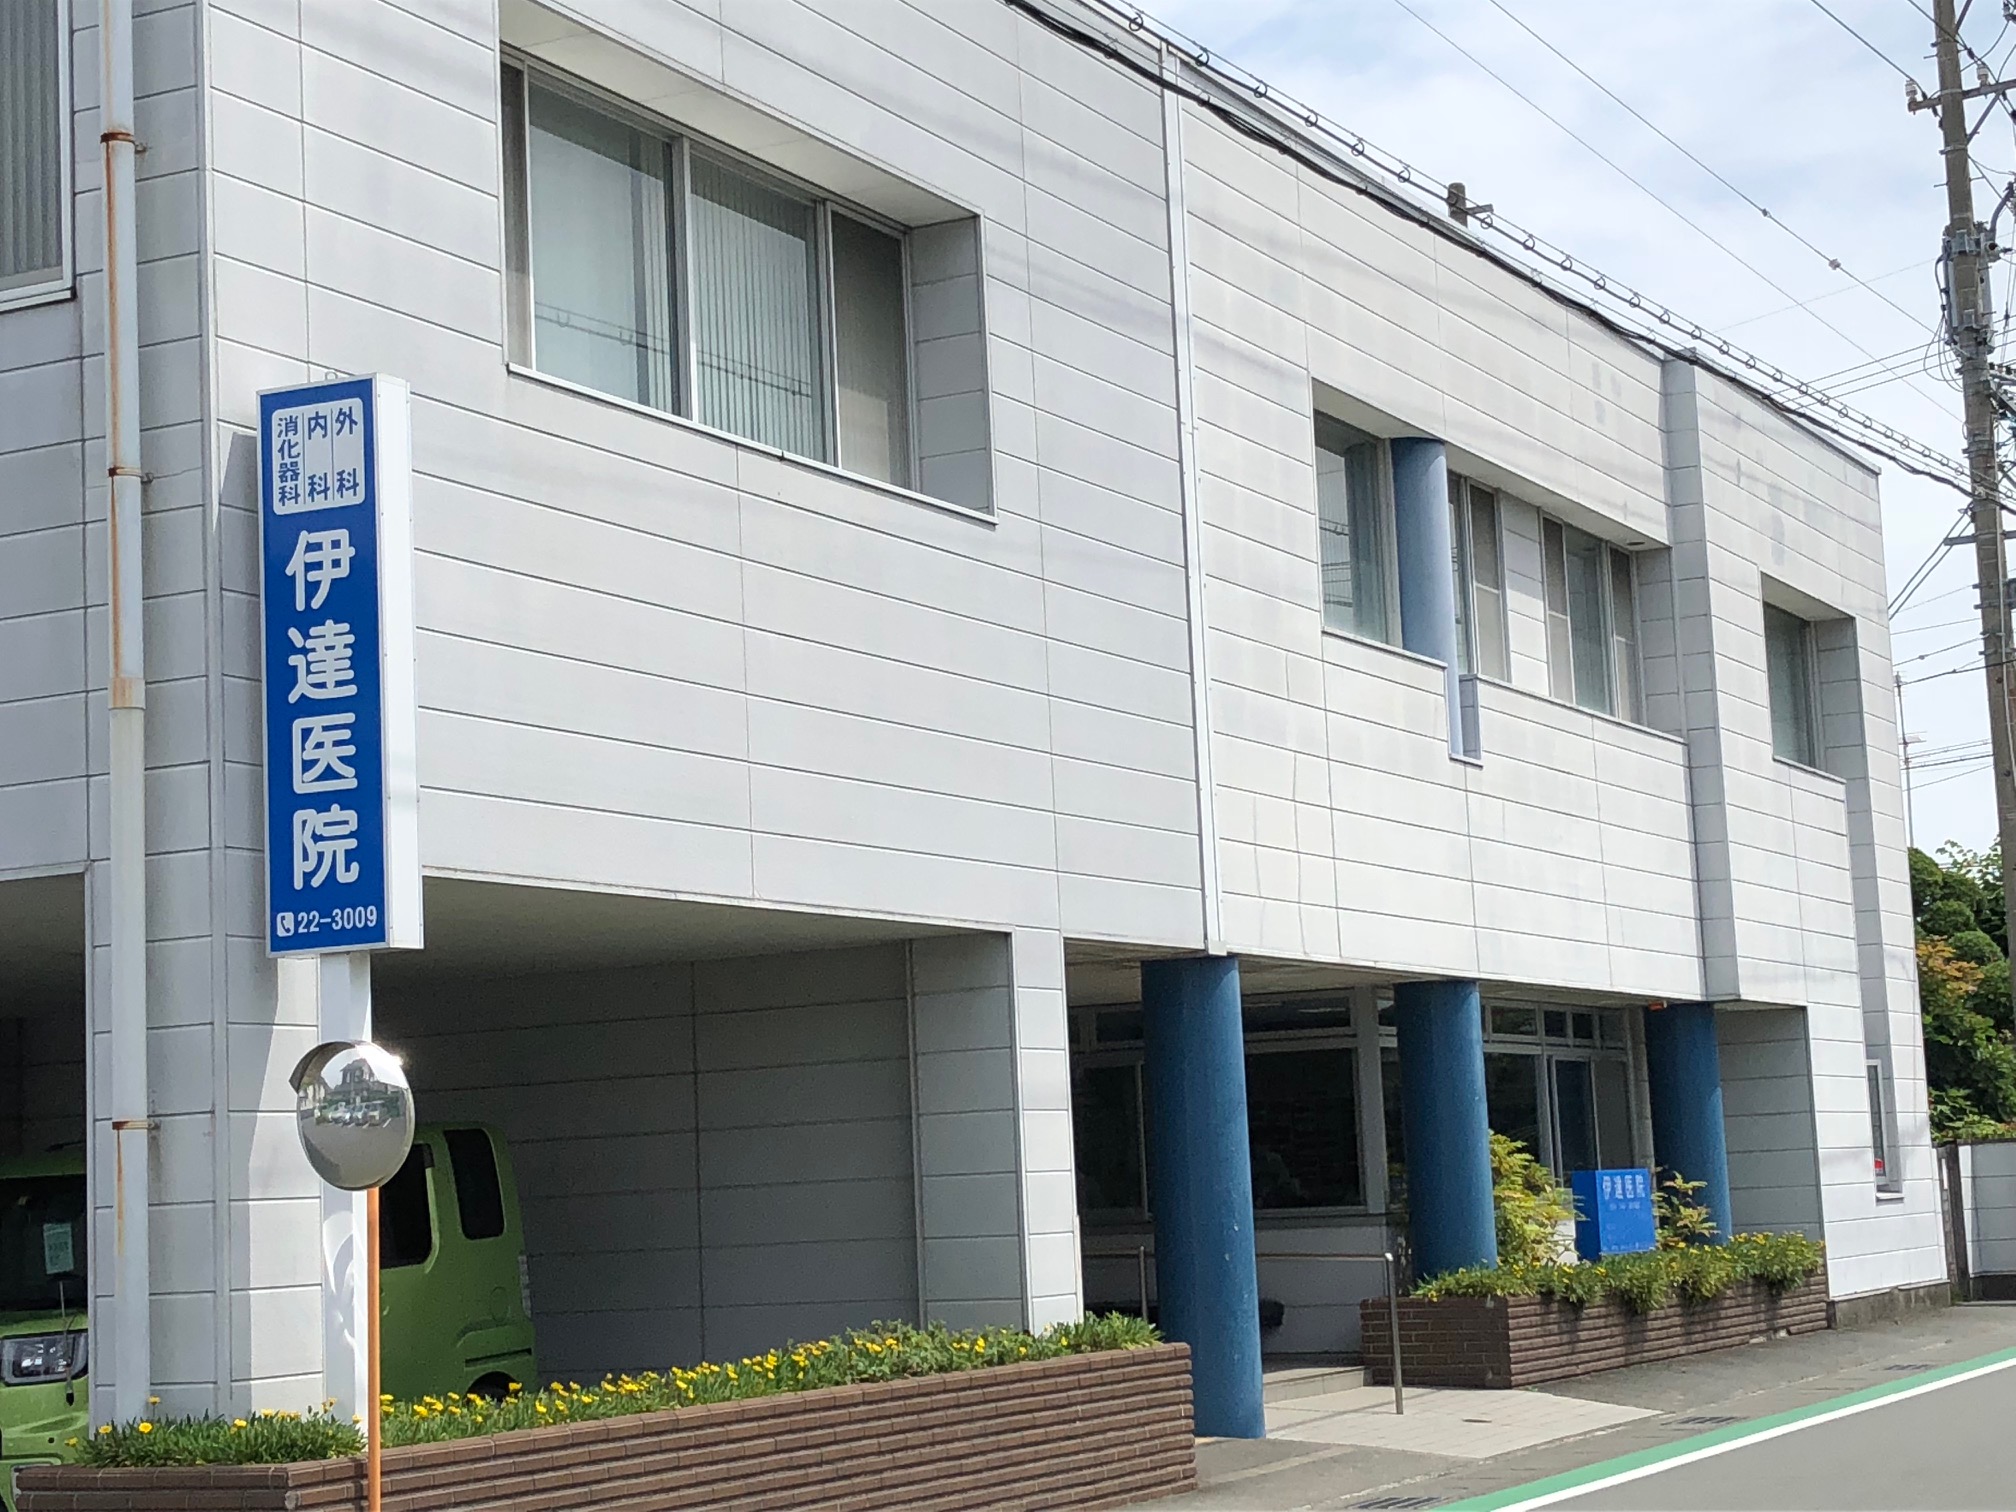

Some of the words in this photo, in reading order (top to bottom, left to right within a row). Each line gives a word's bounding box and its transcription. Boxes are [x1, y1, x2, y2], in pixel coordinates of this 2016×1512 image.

[277, 415, 301, 506] 消化器科
[307, 411, 330, 502] 内科
[335, 406, 359, 498] 外科
[285, 528, 360, 890] 伊達医院
[297, 905, 378, 933] 22-3009
